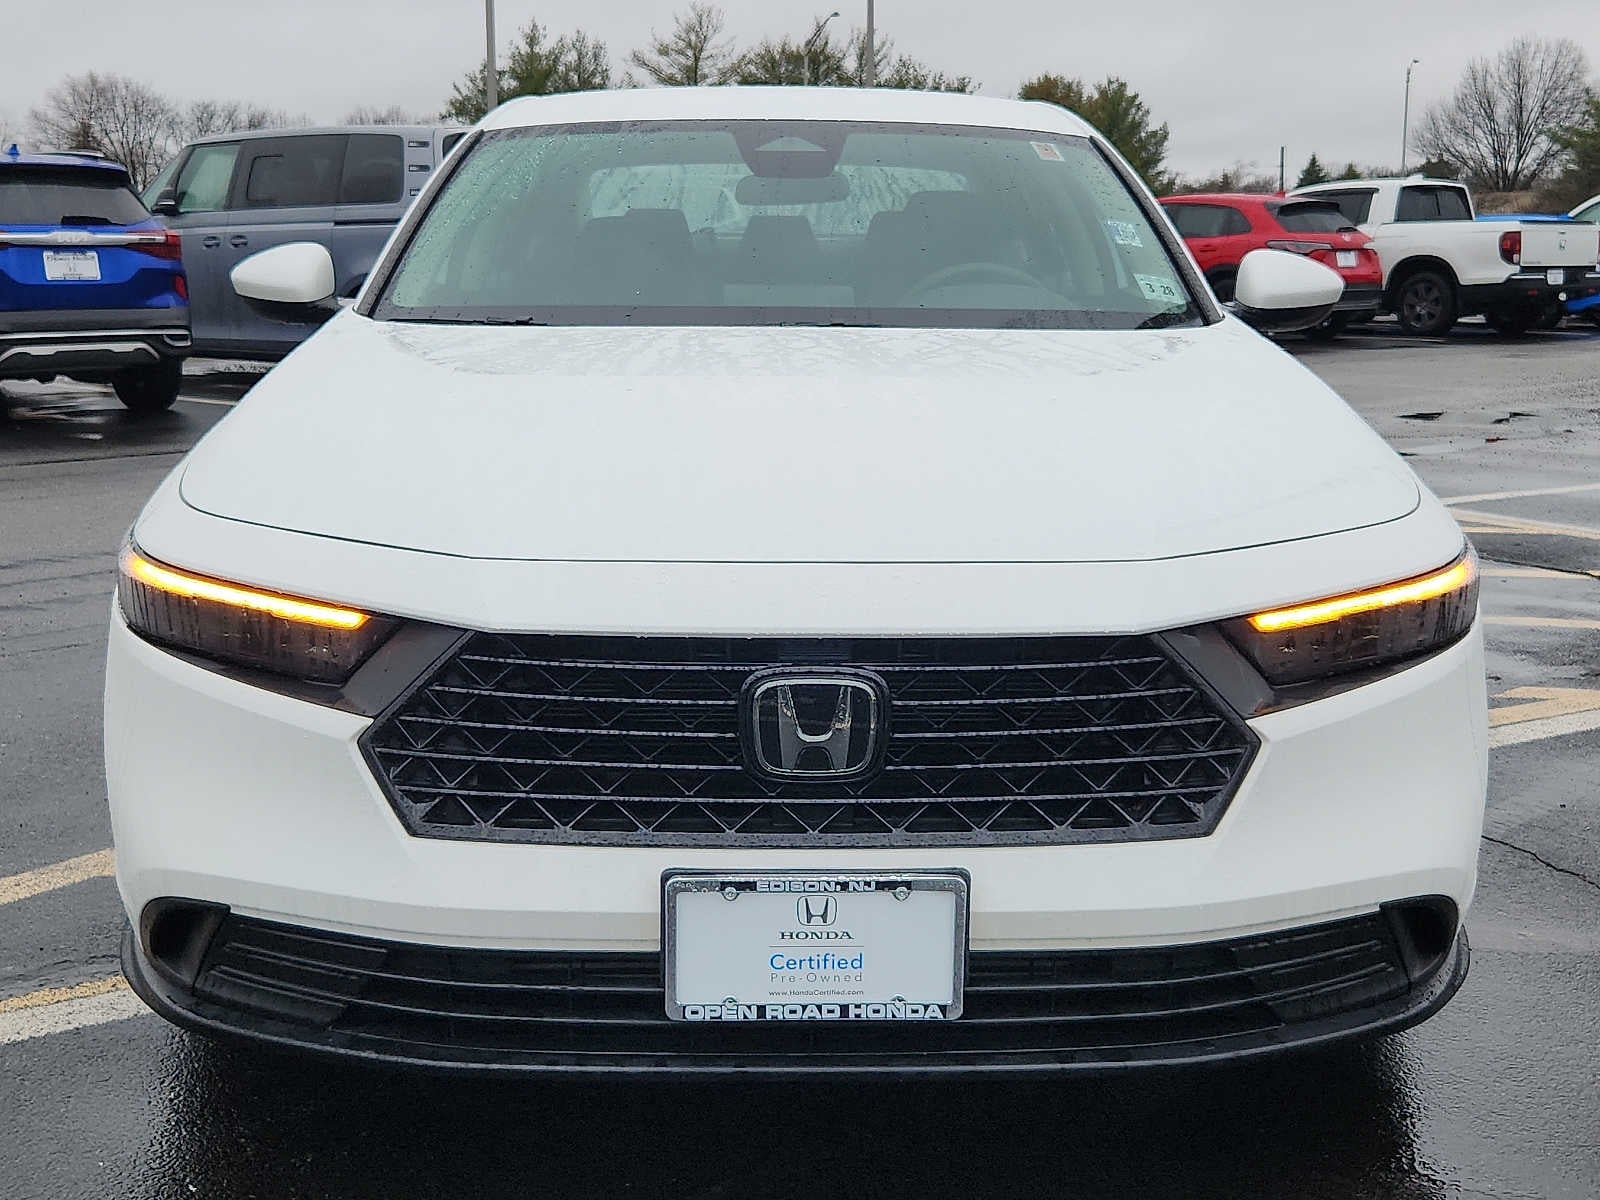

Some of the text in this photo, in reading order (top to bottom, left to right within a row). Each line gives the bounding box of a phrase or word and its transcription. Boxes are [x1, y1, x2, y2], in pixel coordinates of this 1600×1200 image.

[847, 880, 877, 892] NJ
[780, 931, 854, 940] HONDA
[770, 953, 863, 970] Certified
[770, 972, 863, 983] Pre-Owned
[768, 989, 865, 997] www.HondaCertified.com
[685, 1004, 943, 1020] OPEN ROAD HONDA
